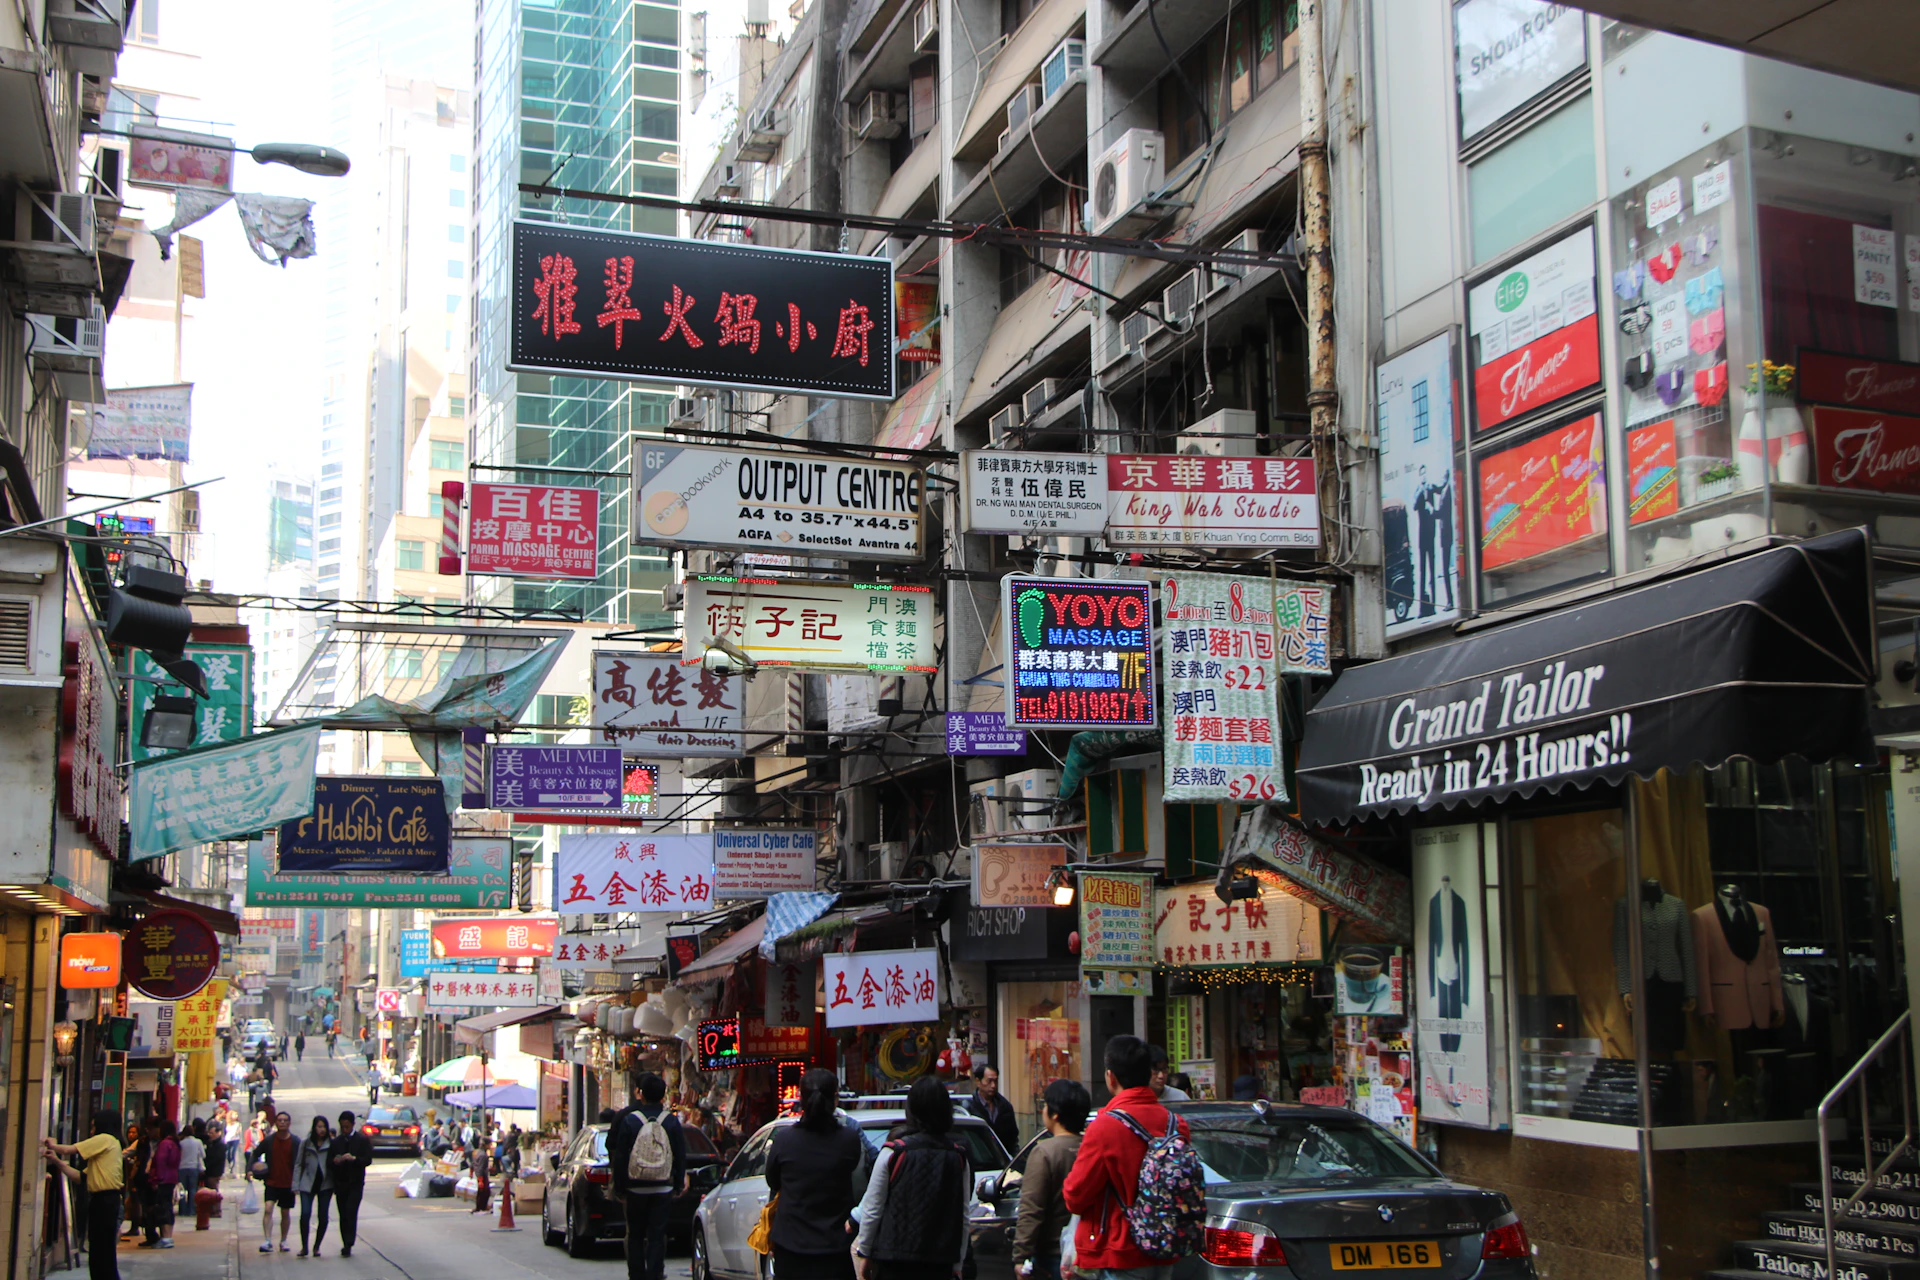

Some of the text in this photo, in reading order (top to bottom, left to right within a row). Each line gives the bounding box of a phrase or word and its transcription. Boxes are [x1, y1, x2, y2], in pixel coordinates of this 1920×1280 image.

[1650, 190, 1677, 215] SALE
[1860, 231, 1886, 245] SALE
[1858, 249, 1890, 264] PANTY
[1870, 290, 1890, 301] pcs
[1657, 299, 1676, 317] HKD
[1663, 336, 1683, 353] pcs
[645, 451, 665, 469] 6F
[978, 458, 1097, 475] 菲律賓東方大學牙科博士
[1119, 457, 1301, 490] 京華攝影
[738, 457, 919, 513] OUTPUT CENTRE
[1021, 478, 1086, 499] 伍偉民
[489, 487, 582, 521] 百佳
[738, 507, 765, 520] A4
[774, 510, 793, 522] to
[1038, 501, 1064, 509] DENTAL
[1126, 493, 1300, 525] King Wah Studio
[472, 518, 594, 545] 按摩中心
[738, 529, 918, 550] AGFA SelectSet Avantra 44
[1115, 530, 1314, 544] 群英商業大廈 8/F Khuan Ying Comm. Bldg
[502, 542, 560, 558] MASSAGE
[563, 548, 594, 560] CENTRE
[1047, 593, 1144, 628] YOYO
[1165, 577, 1273, 624] 2:00PM 至 8:30PM
[706, 603, 843, 641] 筷子記
[1048, 628, 1144, 646] MASSAGE
[1170, 627, 1274, 660] 澳門豬扒包
[1018, 650, 1146, 689] 群英商業大廈 7/F
[1019, 672, 1071, 687] KHUAN YING
[1171, 660, 1267, 690] 送熱飲 $22
[1173, 689, 1217, 715] 澳門
[1388, 661, 1605, 750] Grand Tailor
[704, 716, 728, 729] 1/F
[975, 715, 993, 724] MEI
[1175, 715, 1272, 744] 撈麵套餐
[658, 733, 736, 750] Hair Dressing
[969, 733, 1023, 741] 美容穴位按摩
[539, 749, 607, 763] MEI MEI
[1358, 712, 1632, 807] Ready in 24 Hours!!
[496, 749, 524, 807] 美美
[529, 765, 616, 776] Beauty & Massage
[341, 784, 436, 796] Dinner Late Night
[529, 778, 618, 790] 美容穴位按摩
[1172, 767, 1275, 800] 送熱飲 $26
[318, 803, 430, 846] Habibi Café
[335, 847, 366, 855] Kebabs
[615, 841, 658, 863] 成興
[717, 833, 813, 850] Universal Cyber Café
[482, 873, 506, 885] Co.
[563, 869, 710, 906] 五金漆油
[967, 907, 1025, 936] RICH SHOP
[459, 926, 528, 949] 盛記
[141, 925, 176, 981] 華豐
[1783, 947, 1824, 955] Grand Tailor
[830, 964, 935, 1009] 五金漆油
[384, 995, 392, 1007] K
[1892, 1172, 1911, 1187] 24
[1868, 1202, 1905, 1218] 2,980
[1768, 1222, 1914, 1253] Shirt For 3 Pcs
[1340, 1244, 1429, 1266] DM 166
[1754, 1252, 1810, 1279] Tailor
